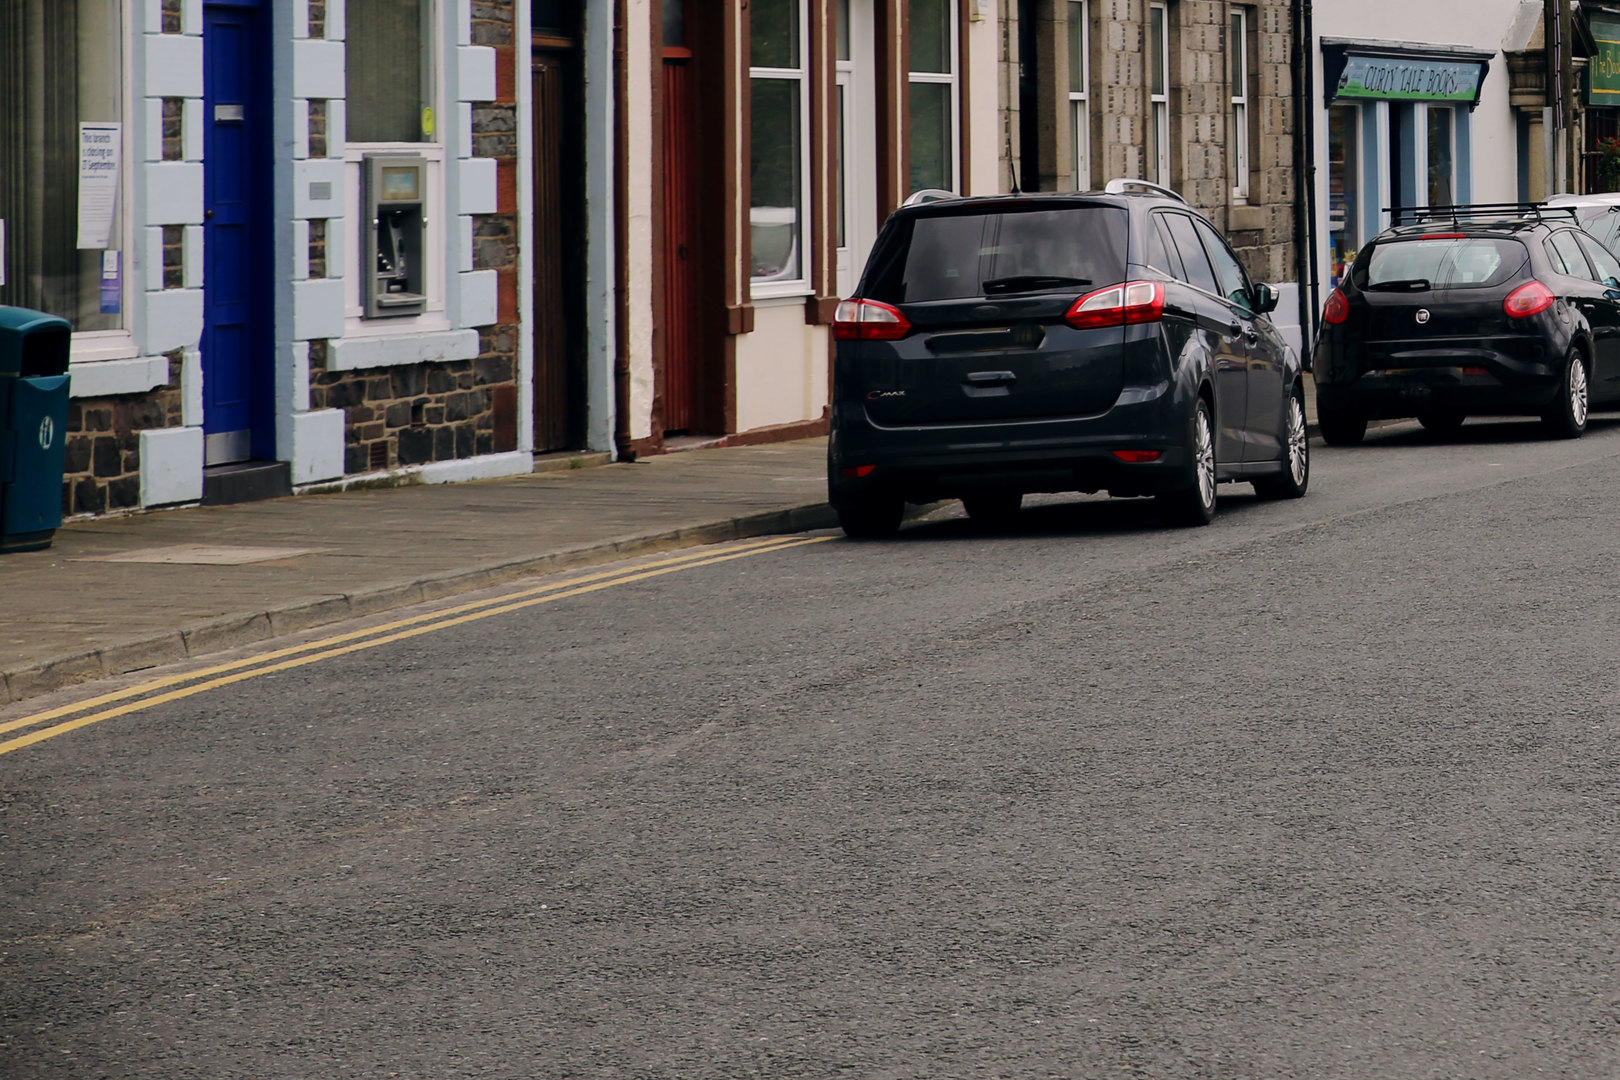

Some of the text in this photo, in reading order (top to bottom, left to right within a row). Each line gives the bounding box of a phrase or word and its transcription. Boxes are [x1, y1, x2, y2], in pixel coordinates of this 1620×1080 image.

[1364, 65, 1398, 94] CURLY
[1400, 67, 1424, 94] TALE
[1426, 69, 1457, 98] BOOKS
